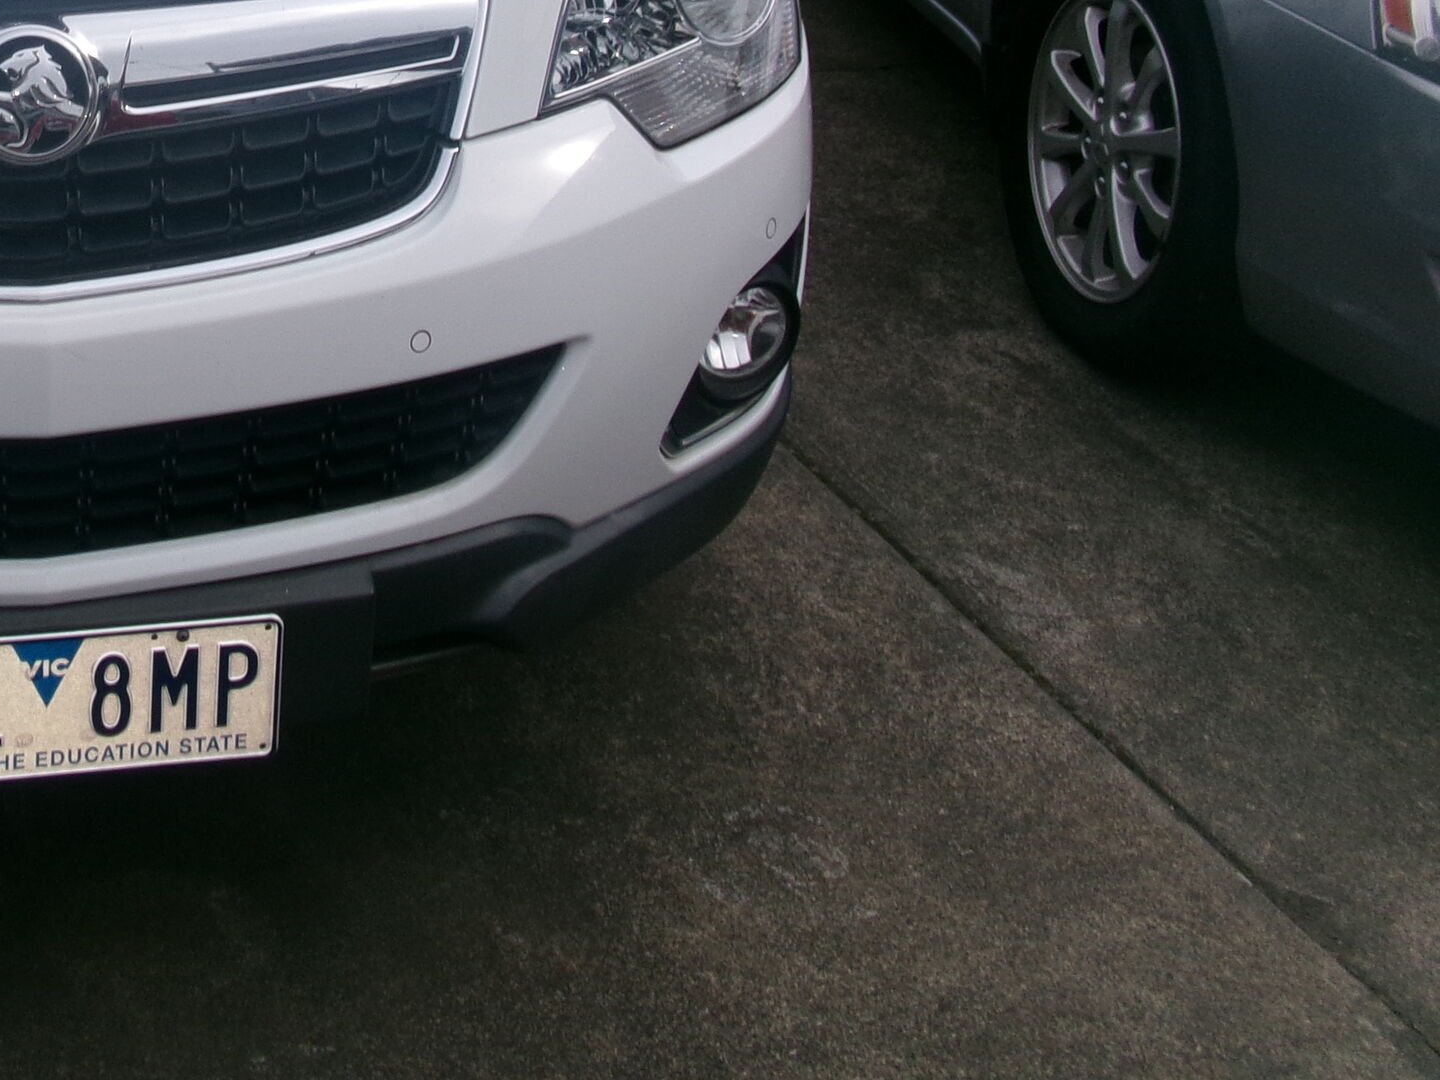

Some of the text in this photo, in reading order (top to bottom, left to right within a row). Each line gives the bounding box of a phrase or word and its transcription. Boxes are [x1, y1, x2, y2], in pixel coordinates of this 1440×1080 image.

[21, 657, 70, 679] VIC
[90, 640, 259, 737] 8MP
[36, 740, 170, 768] EDUCATION
[179, 732, 248, 755] STATE
